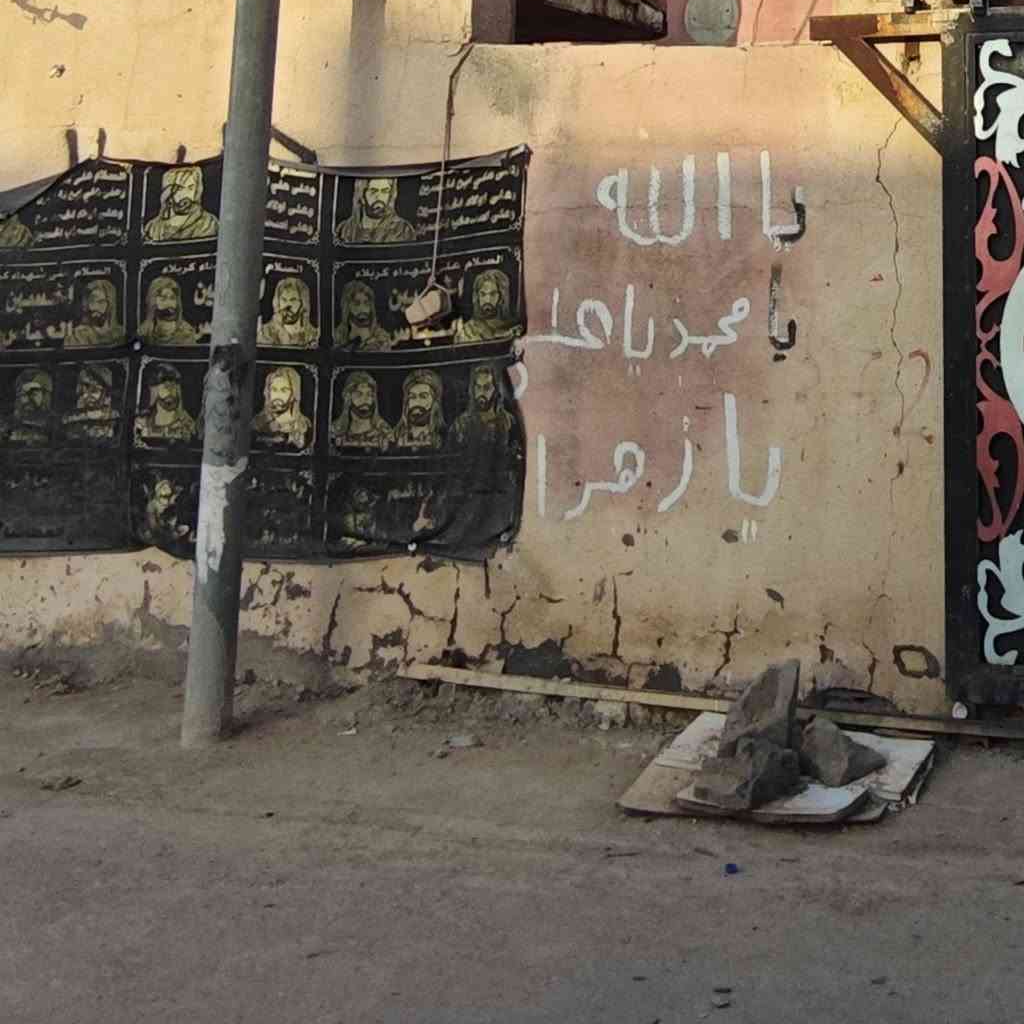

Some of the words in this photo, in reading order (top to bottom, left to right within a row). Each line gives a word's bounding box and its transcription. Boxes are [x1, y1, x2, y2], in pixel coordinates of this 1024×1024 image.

[597, 151, 734, 247] الله
[760, 150, 806, 251] يا
[668, 296, 751, 359] محمد
[723, 392, 783, 544] يا
